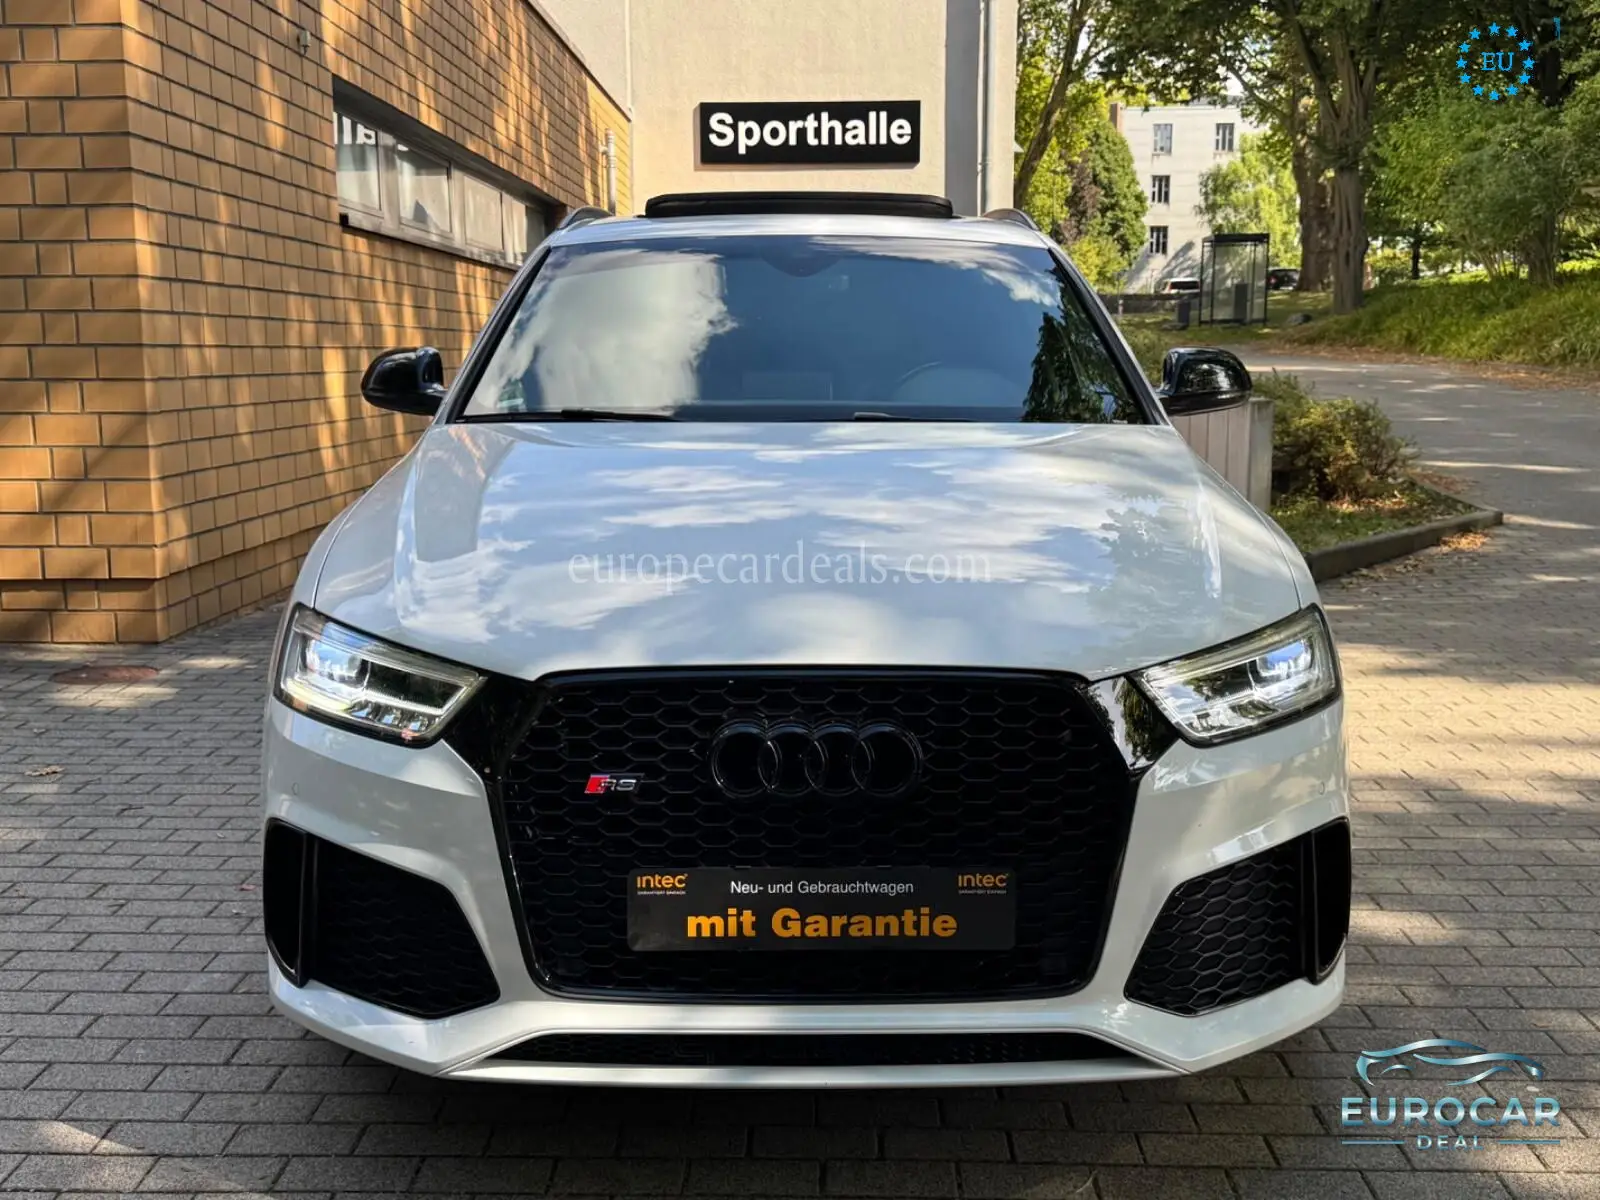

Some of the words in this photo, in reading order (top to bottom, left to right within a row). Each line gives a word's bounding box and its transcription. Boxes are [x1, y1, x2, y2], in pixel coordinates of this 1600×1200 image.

[708, 111, 912, 154] Sporthalle
[731, 881, 763, 894] Neu-
[768, 881, 793, 894] und
[798, 881, 914, 896] Gebrauchtwagen
[687, 908, 756, 937] mit
[772, 907, 958, 937] Garantie
